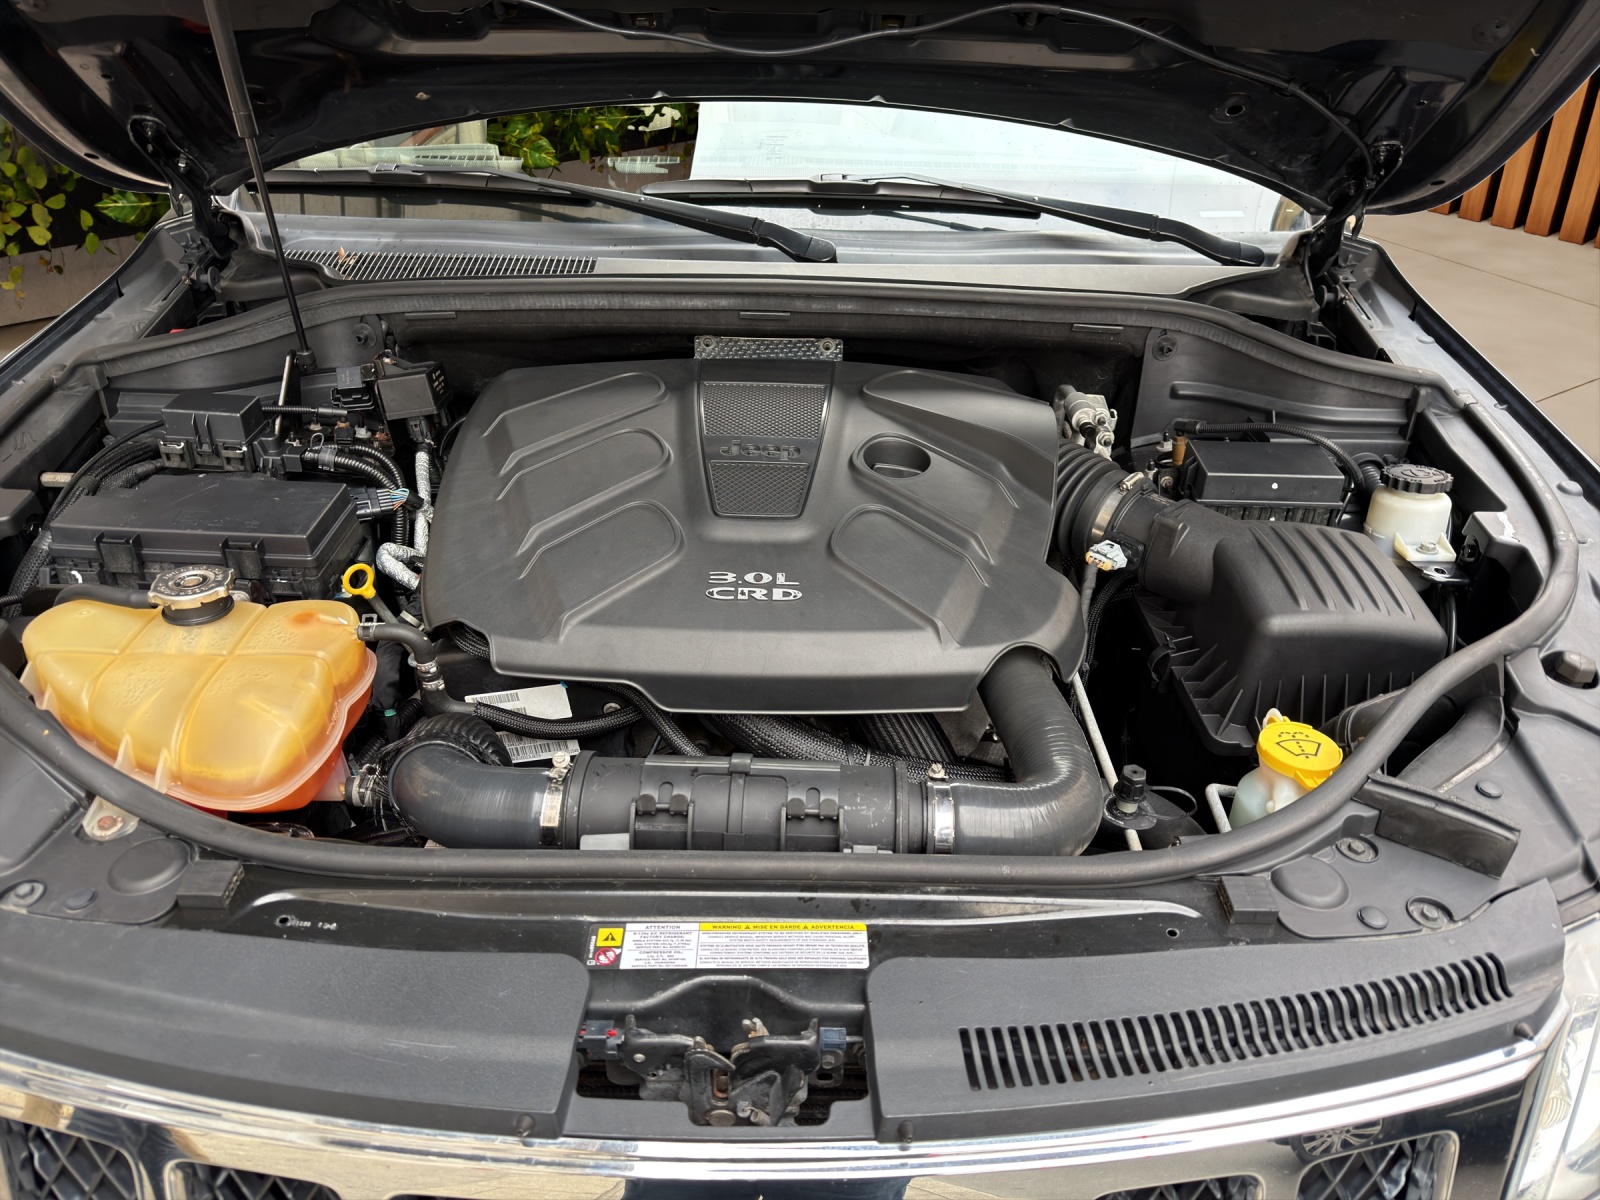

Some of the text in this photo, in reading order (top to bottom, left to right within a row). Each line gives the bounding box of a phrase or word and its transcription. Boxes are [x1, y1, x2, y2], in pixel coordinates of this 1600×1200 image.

[720, 439, 801, 461] Jeep
[708, 571, 800, 585] 3.0L
[705, 586, 803, 601] CRD
